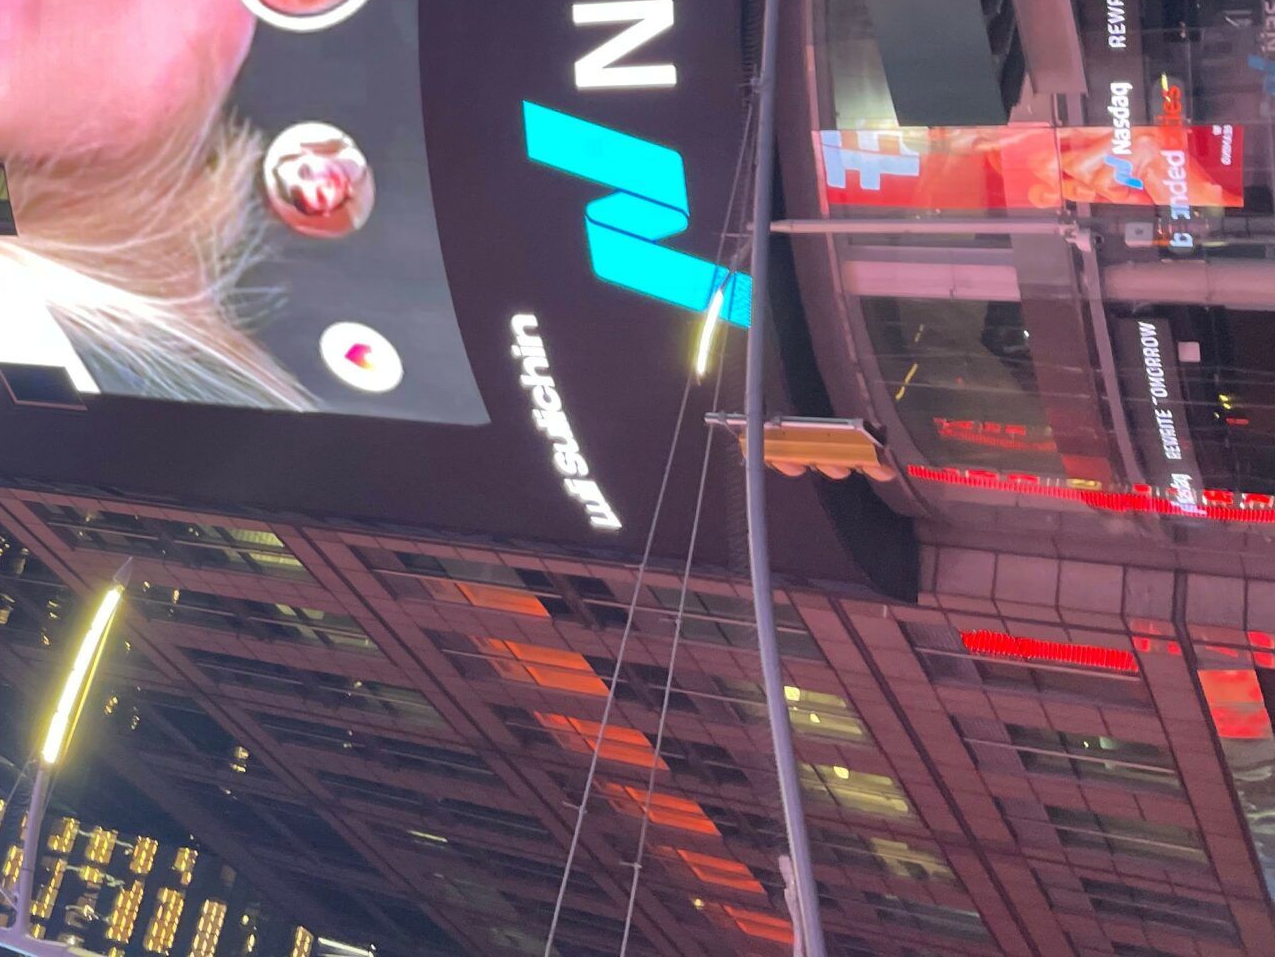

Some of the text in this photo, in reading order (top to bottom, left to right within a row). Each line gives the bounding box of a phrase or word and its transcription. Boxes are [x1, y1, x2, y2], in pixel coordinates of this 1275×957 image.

[1107, 81, 1133, 155] Nasdaq
[1160, 149, 1193, 247] banded
[1154, 408, 1182, 460] REWRITE
